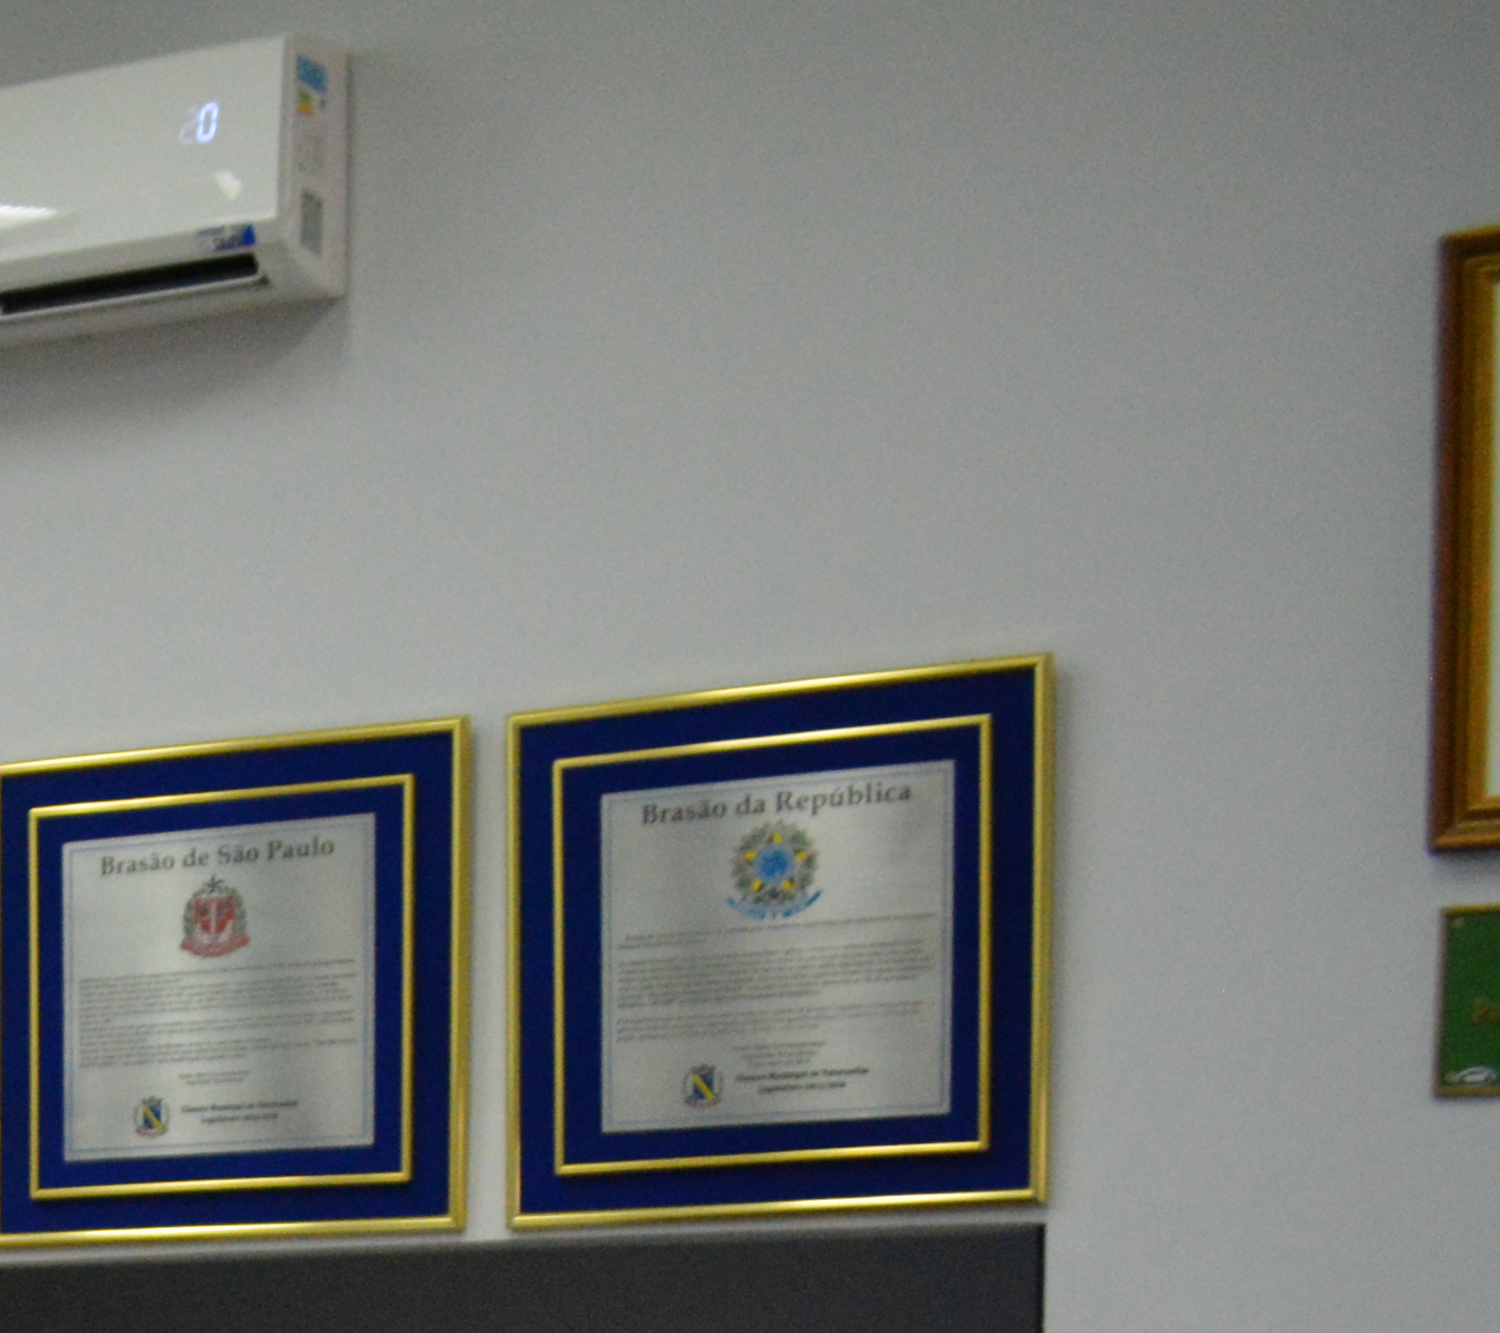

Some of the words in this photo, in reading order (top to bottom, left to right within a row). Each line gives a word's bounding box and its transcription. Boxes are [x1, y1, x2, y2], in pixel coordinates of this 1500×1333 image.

[641, 801, 727, 826] Brasão
[735, 793, 766, 816] da
[774, 782, 912, 816] República
[101, 854, 176, 877] Brasão
[182, 848, 212, 868] de
[217, 845, 260, 866] São
[267, 835, 335, 862] Paulo
